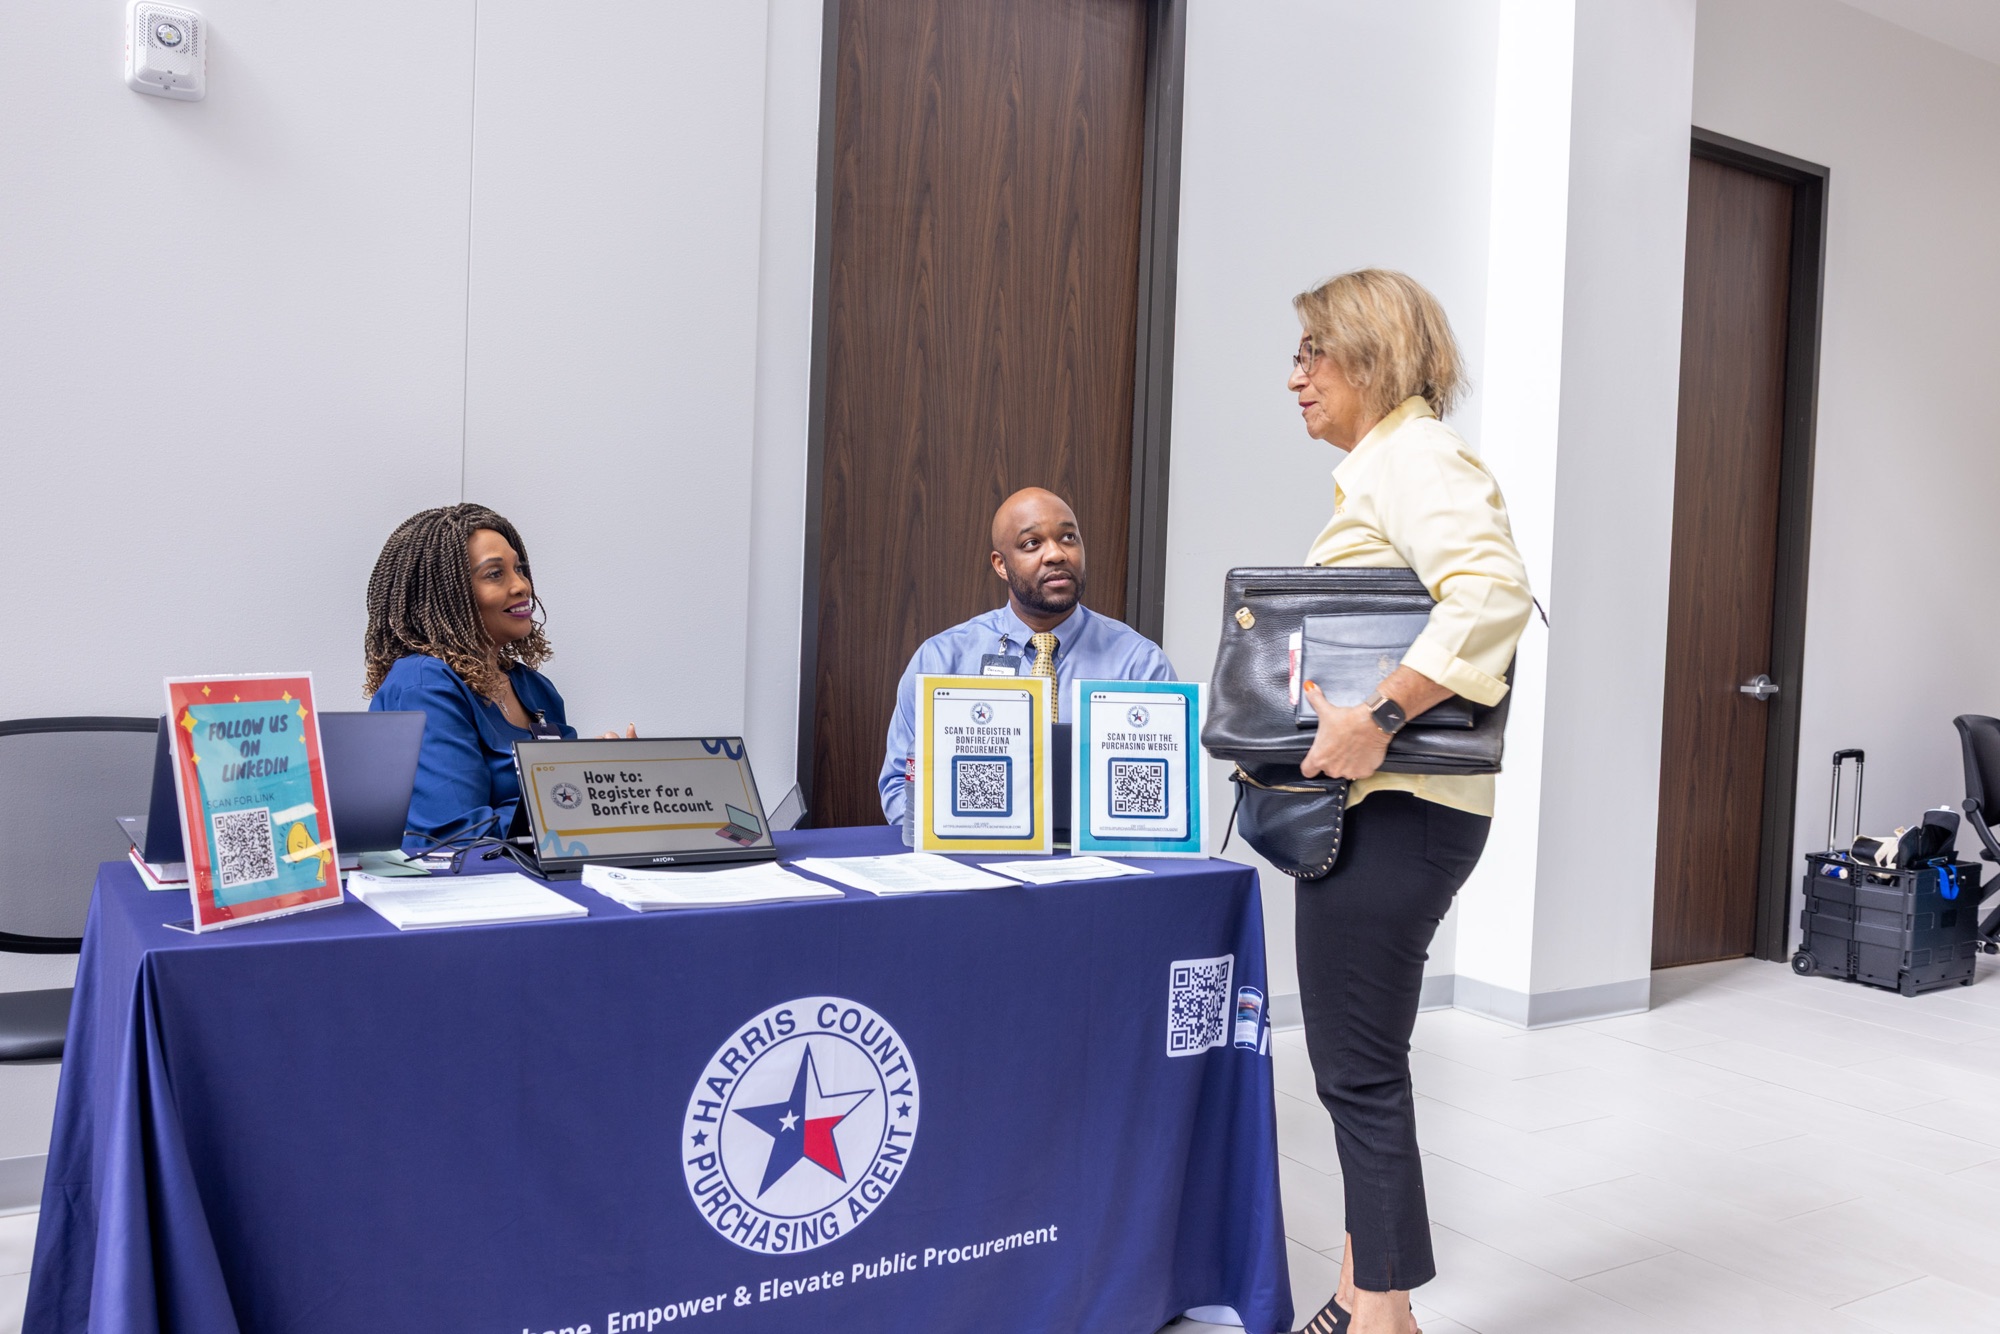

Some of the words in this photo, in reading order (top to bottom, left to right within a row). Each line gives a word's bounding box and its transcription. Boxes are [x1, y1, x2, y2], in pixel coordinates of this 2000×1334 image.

[209, 717, 265, 741] FOLLOW
[269, 714, 288, 733] US
[944, 726, 964, 735] SCAN
[966, 727, 975, 735] TO
[977, 727, 1011, 736] REGISTER
[1013, 727, 1021, 736] IN
[955, 736, 1010, 745] BONFIRE/EUNA
[1107, 732, 1126, 741] SCAN
[1128, 733, 1137, 742] TO
[1139, 733, 1157, 742] VISIT
[1159, 734, 1173, 742] THE
[240, 739, 261, 758] ON
[955, 745, 1008, 754] PROCUREMENT
[1101, 741, 1146, 751] PURCHASING
[1147, 742, 1179, 751] WEBSITE
[222, 756, 289, 783] LINKEDIN
[583, 771, 615, 784] How
[620, 771, 643, 783] to:
[206, 798, 232, 809] SCAN
[234, 796, 253, 806] FOR
[255, 793, 276, 803] LINK
[587, 785, 651, 802] Register
[655, 785, 680, 798] for
[684, 787, 694, 797] a
[591, 801, 650, 816] Bonfire
[653, 800, 714, 814] Account
[692, 1009, 796, 1123] HARRIS
[817, 1002, 913, 1097] COUNTY
[687, 1151, 840, 1252] PURCHASING
[847, 1124, 913, 1224] AGENT
[607, 1293, 727, 1334] Empower
[733, 1286, 751, 1307] &
[759, 1270, 844, 1302] Elevate
[851, 1252, 917, 1283] Public
[923, 1224, 1058, 1268] Procurement
